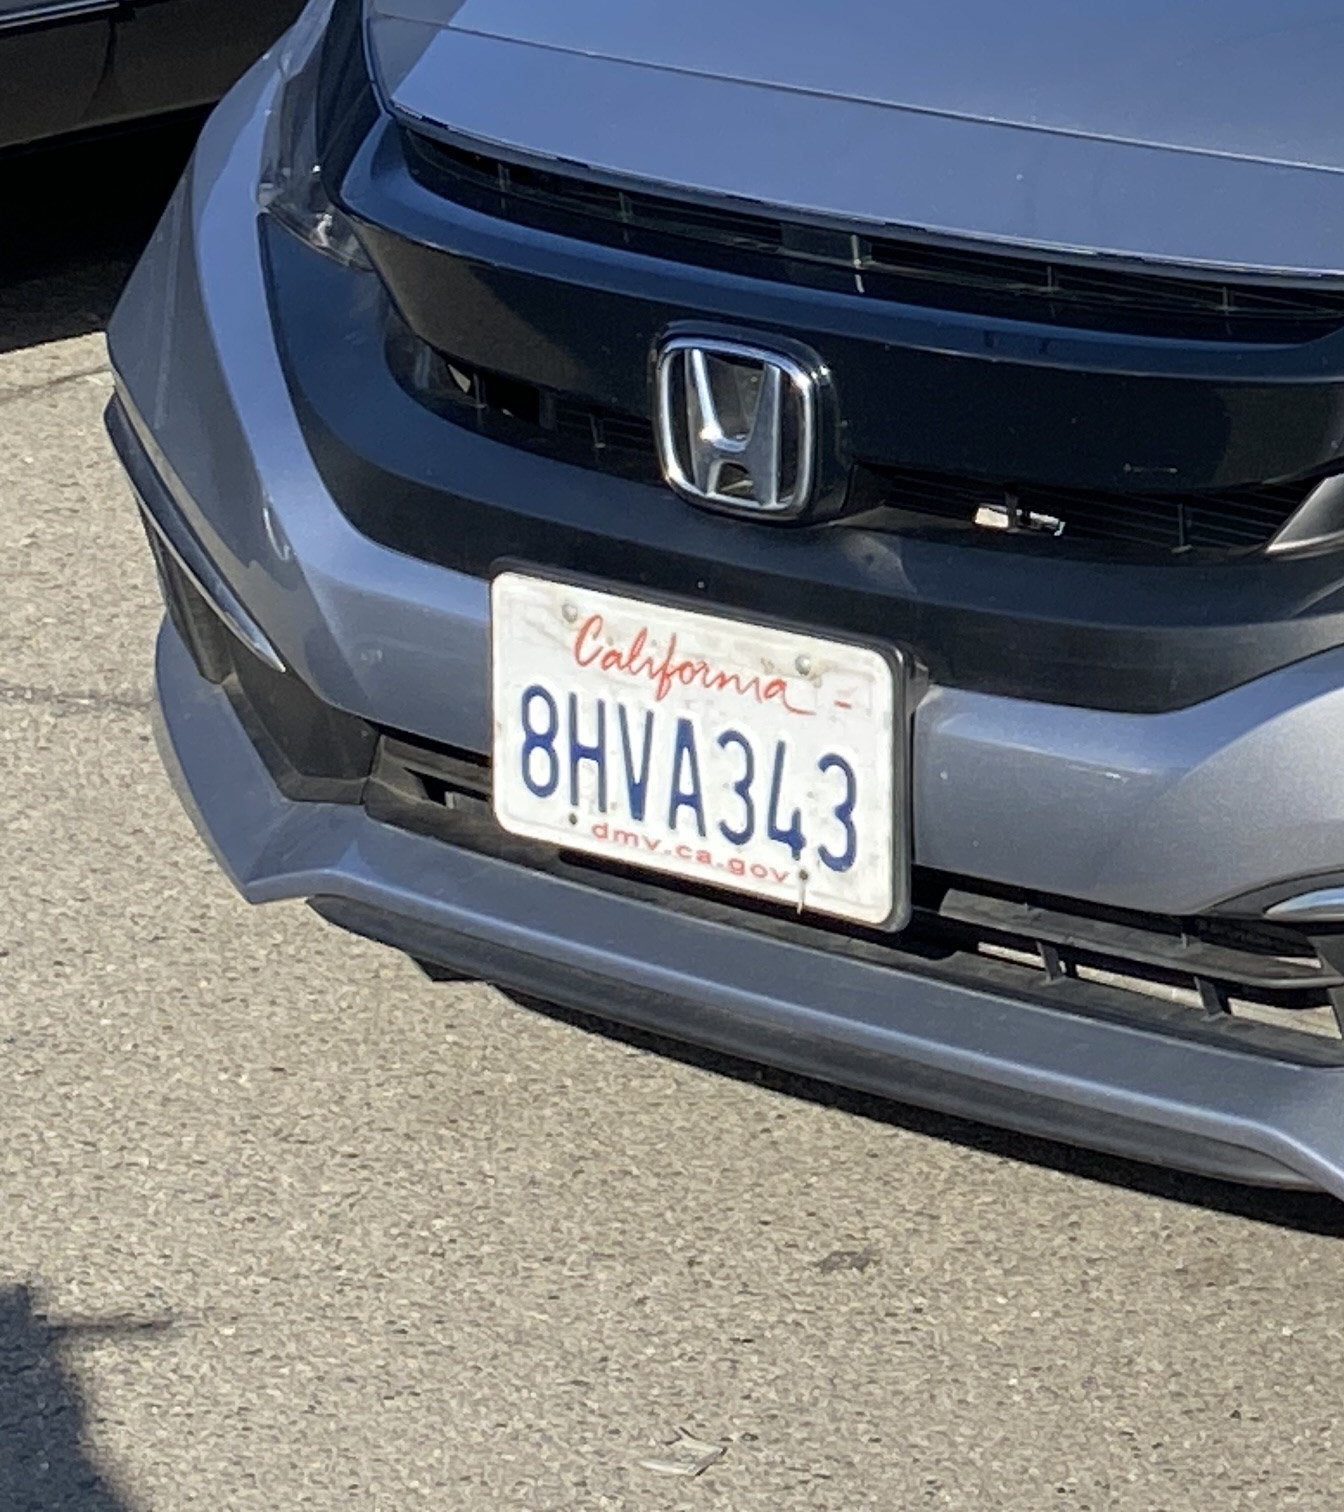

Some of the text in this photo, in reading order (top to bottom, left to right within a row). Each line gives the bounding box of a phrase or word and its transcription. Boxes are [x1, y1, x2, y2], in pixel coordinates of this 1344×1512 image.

[573, 614, 817, 716] California
[521, 684, 858, 873] 8HVA343
[592, 822, 790, 884] dmv.ca.gov
